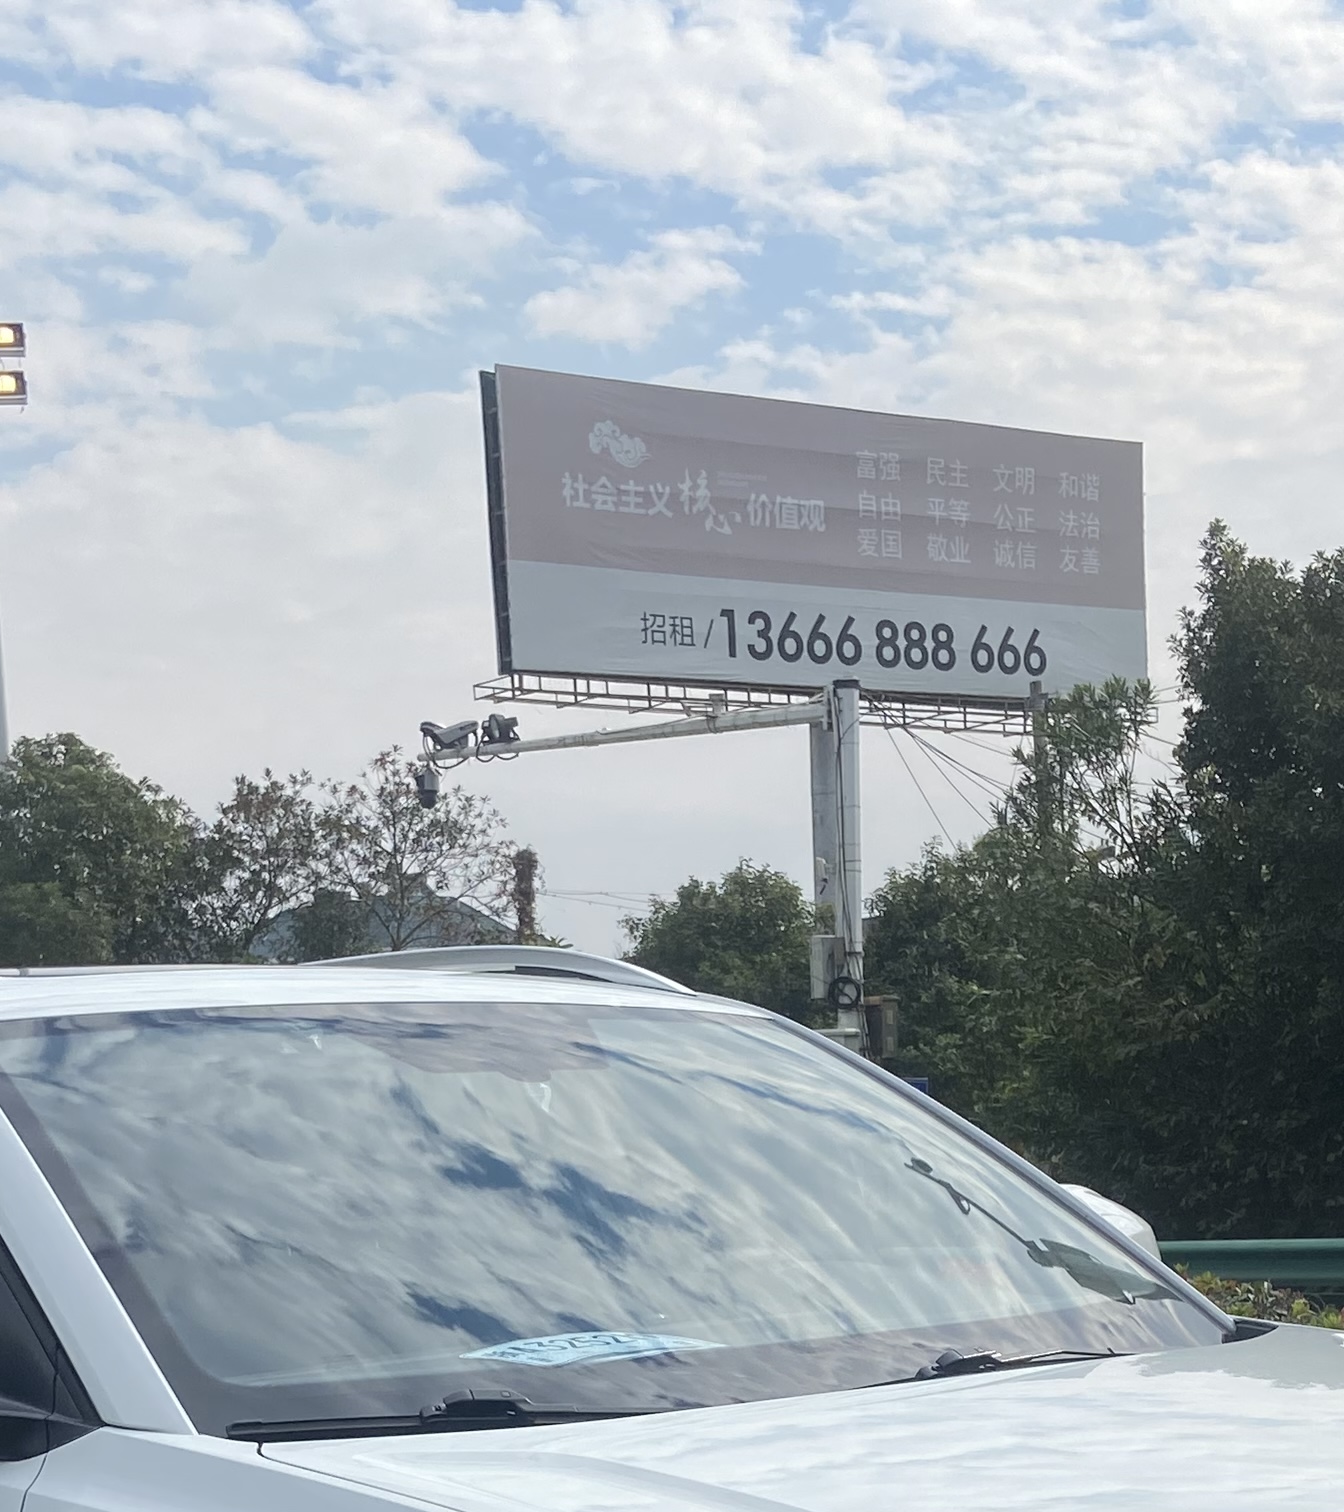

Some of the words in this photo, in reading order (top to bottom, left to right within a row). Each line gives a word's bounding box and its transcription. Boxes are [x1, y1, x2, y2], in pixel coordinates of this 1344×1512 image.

[856, 449, 901, 481] 富强
[926, 456, 969, 489] 民主
[993, 463, 1036, 496] 文明
[1059, 471, 1100, 502] 和谐
[858, 489, 902, 522] 自由
[926, 497, 971, 528] 平等
[993, 503, 1036, 534] 公正
[1059, 509, 1100, 540] 法治
[857, 527, 903, 559] 爱国
[926, 533, 971, 563] 敬业
[993, 539, 1038, 570] 诚信
[1059, 545, 1101, 575] 友善
[875, 618, 956, 672] 888
[971, 624, 1047, 677] 666
